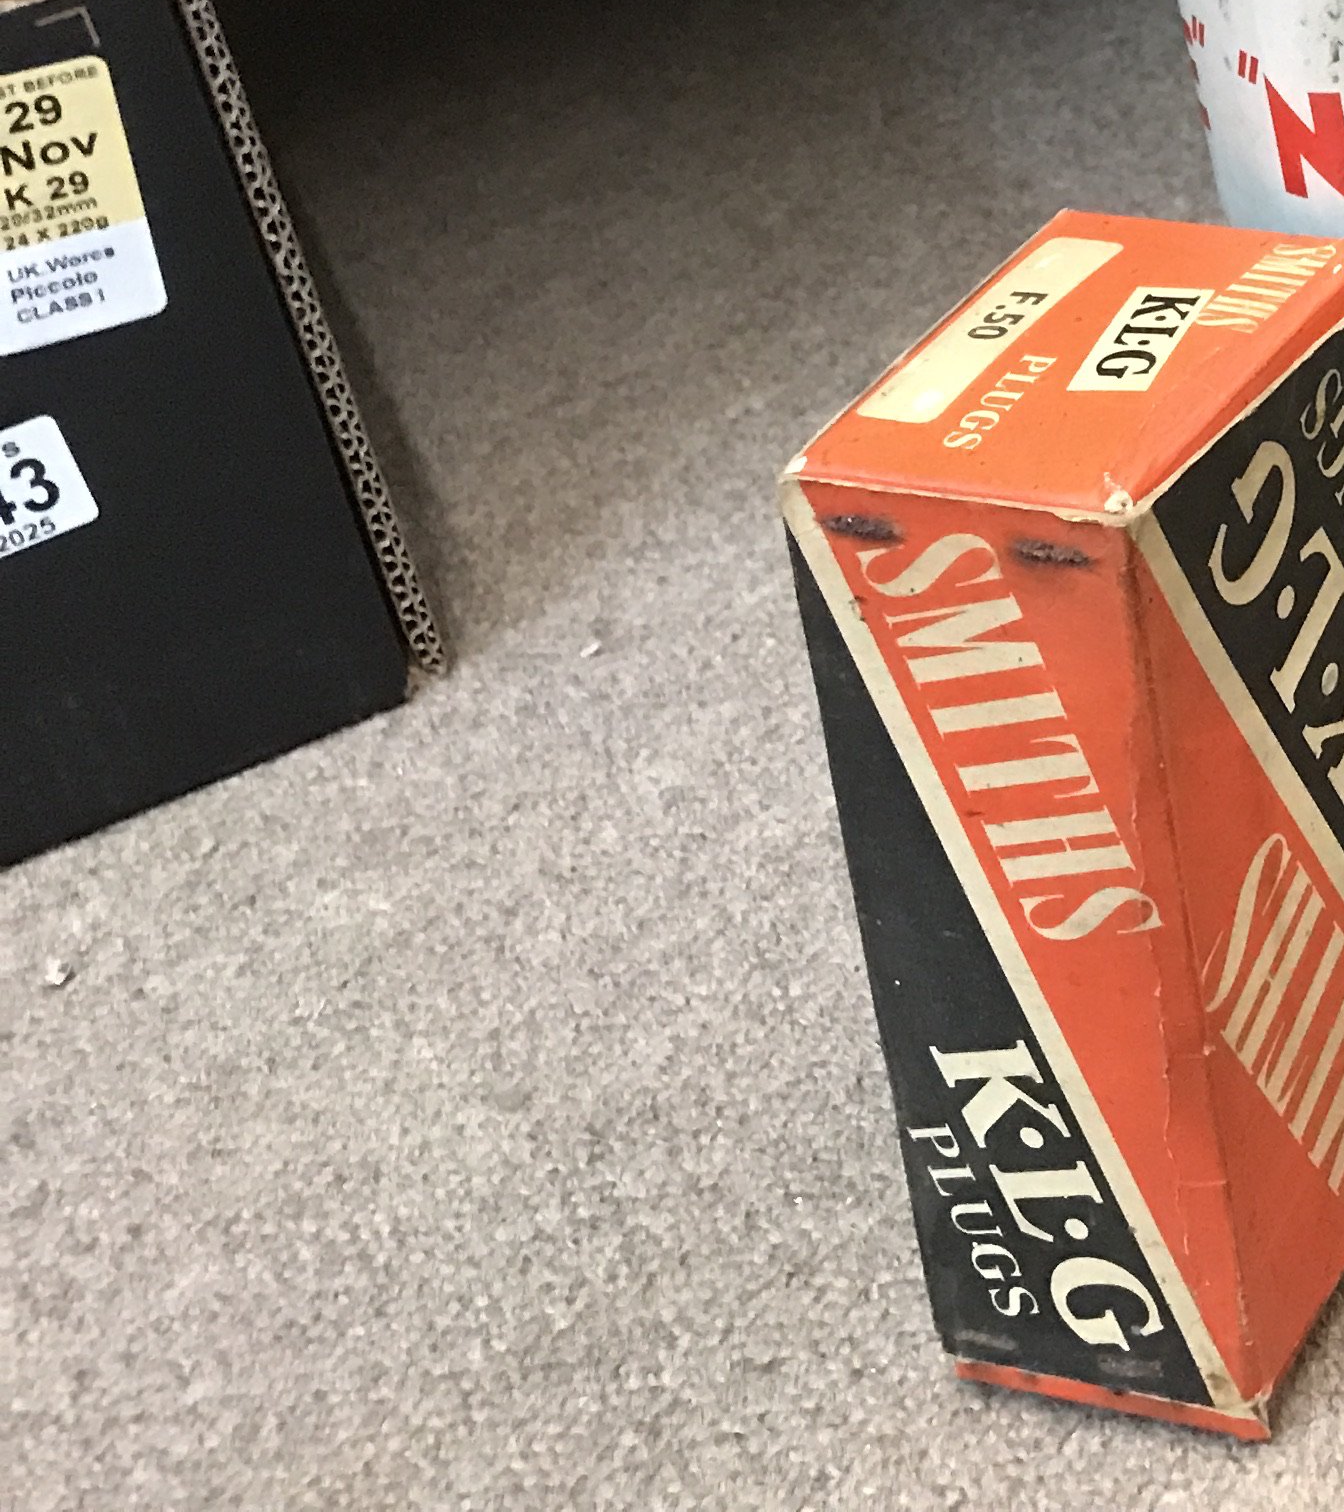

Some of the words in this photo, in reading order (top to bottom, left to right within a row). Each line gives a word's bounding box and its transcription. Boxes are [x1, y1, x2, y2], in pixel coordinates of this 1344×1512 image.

[23, 65, 98, 93] BEFORE
[5, 94, 63, 135] 29
[0, 131, 99, 177] Nov
[46, 170, 90, 202] 29
[5, 234, 30, 252] 24
[57, 216, 110, 238] 220g
[11, 270, 99, 305] Piccolo
[17, 291, 93, 325] CLASS
[1194, 242, 1337, 335] SMITHS
[943, 354, 1058, 451] PLUGS
[855, 531, 1165, 942] SMITHS
[906, 1120, 1042, 1319] PLUGS
